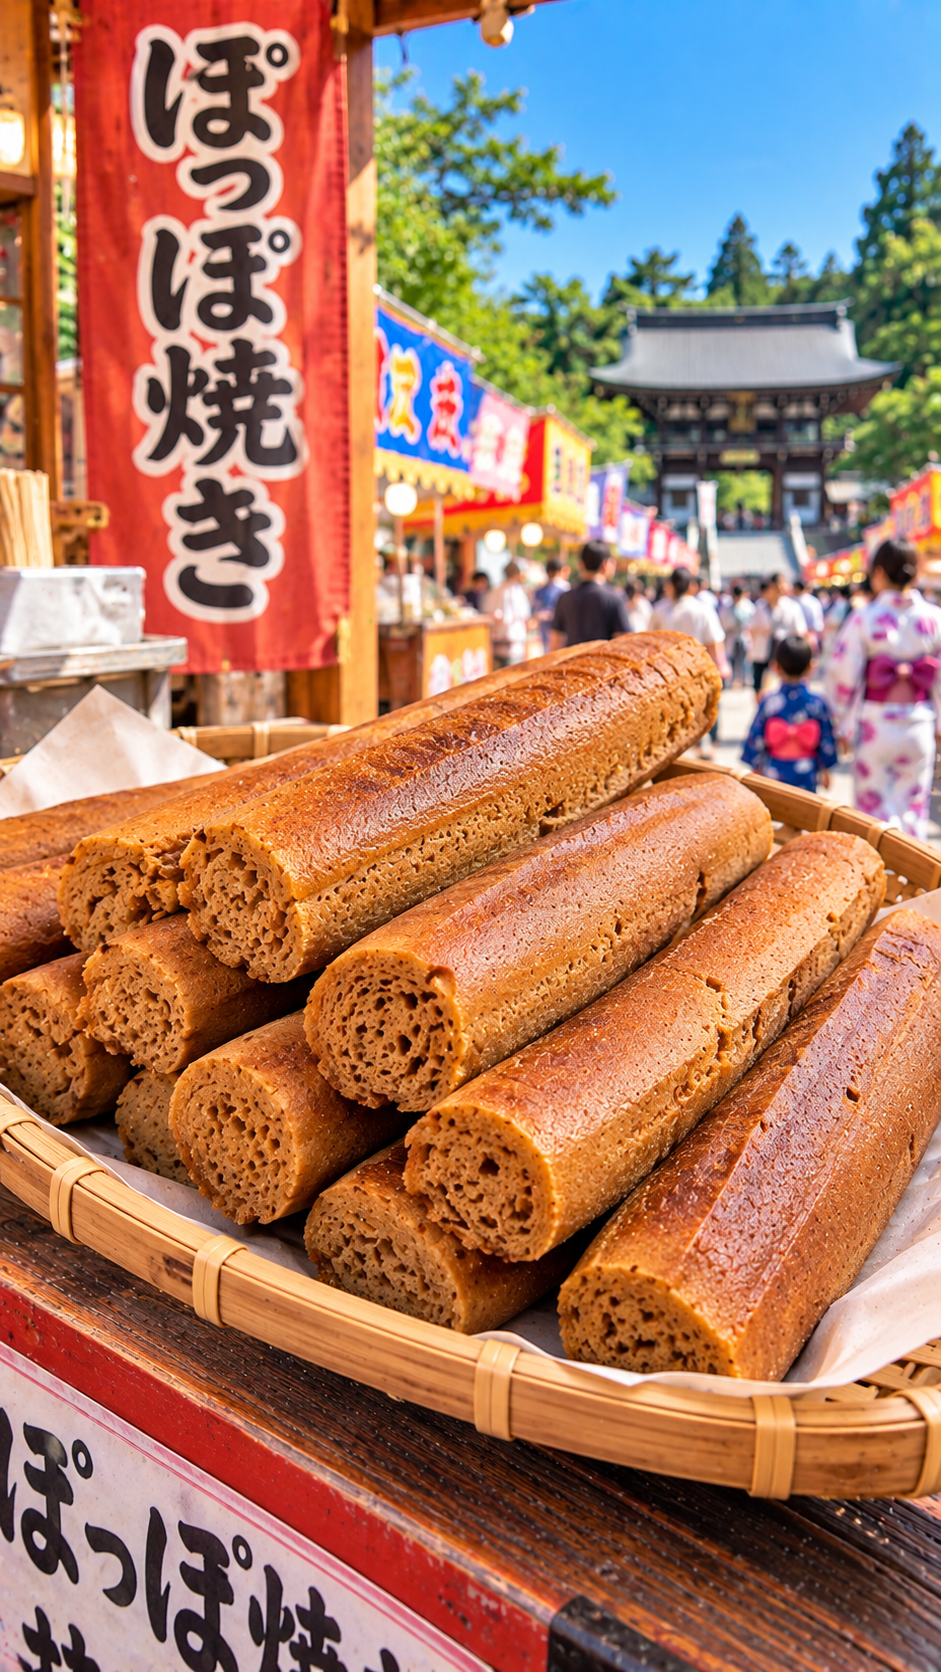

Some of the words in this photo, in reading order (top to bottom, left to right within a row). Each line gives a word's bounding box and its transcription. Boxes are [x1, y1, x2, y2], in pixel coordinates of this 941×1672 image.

[143, 34, 300, 610] ぽっぽ焼き
